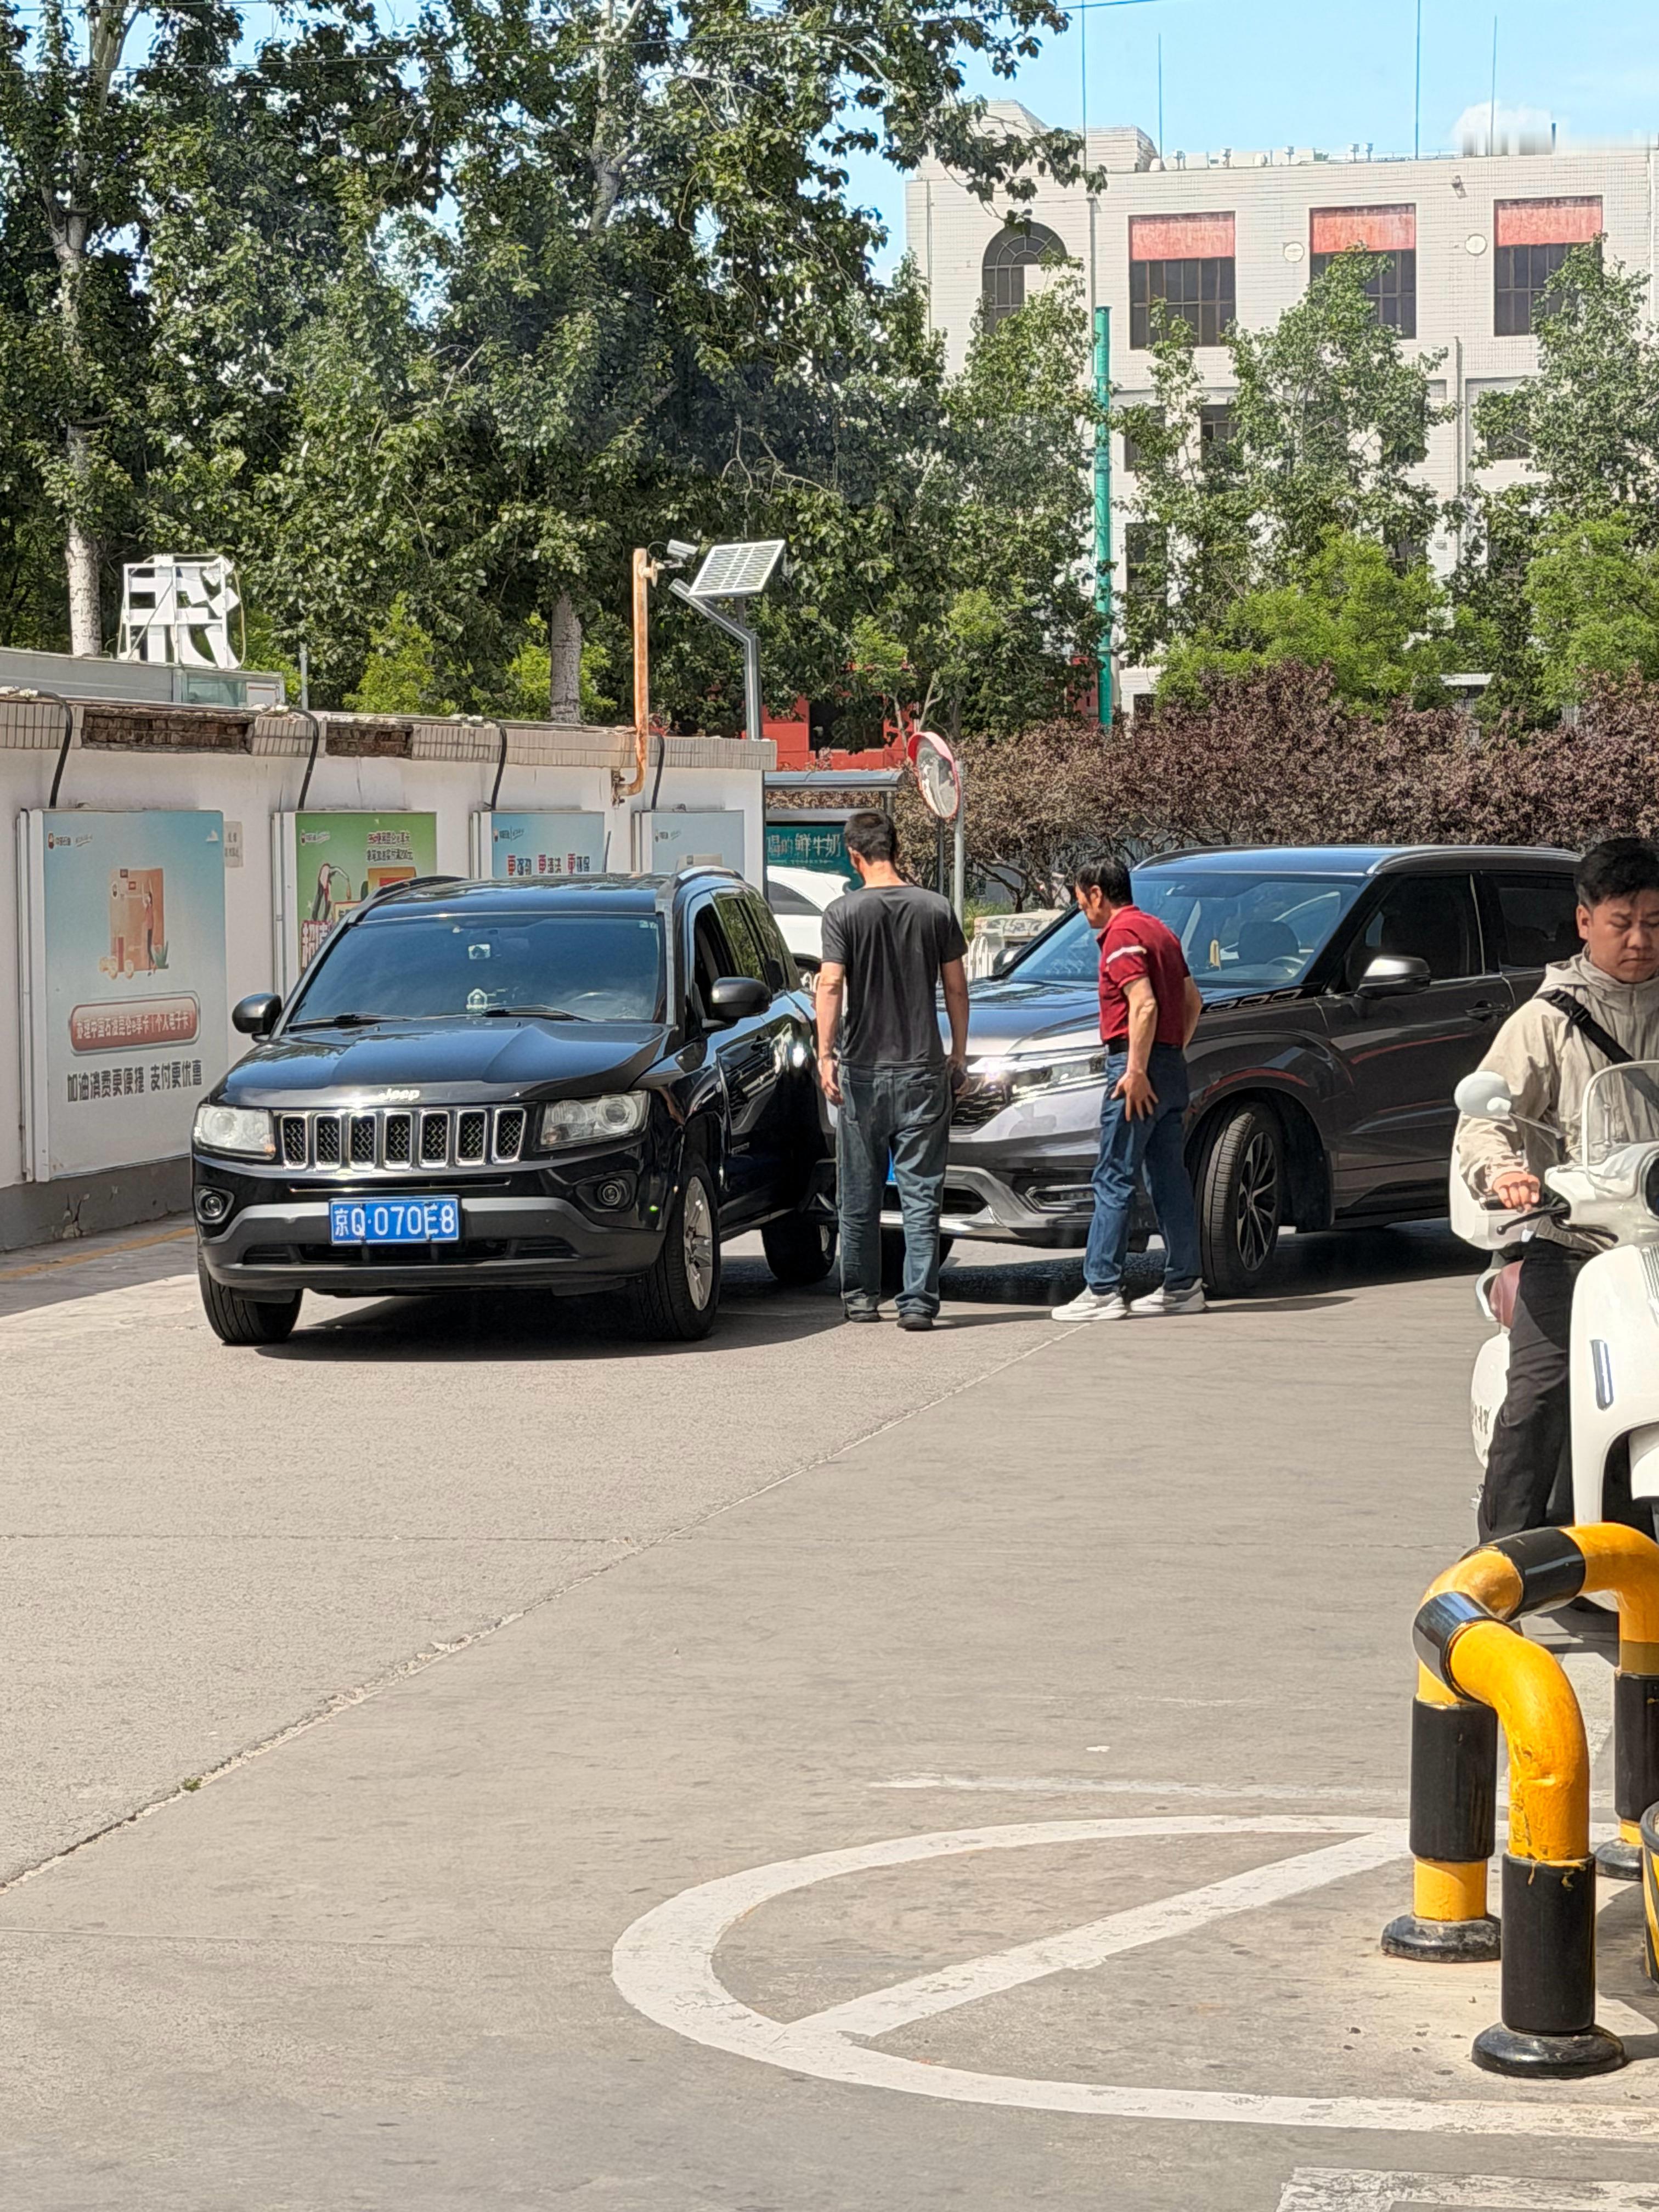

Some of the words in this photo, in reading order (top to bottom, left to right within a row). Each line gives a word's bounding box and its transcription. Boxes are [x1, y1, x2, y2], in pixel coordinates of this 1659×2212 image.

[150, 1059, 202, 1092] 支付更优惠
[379, 1088, 420, 1101] Jeep
